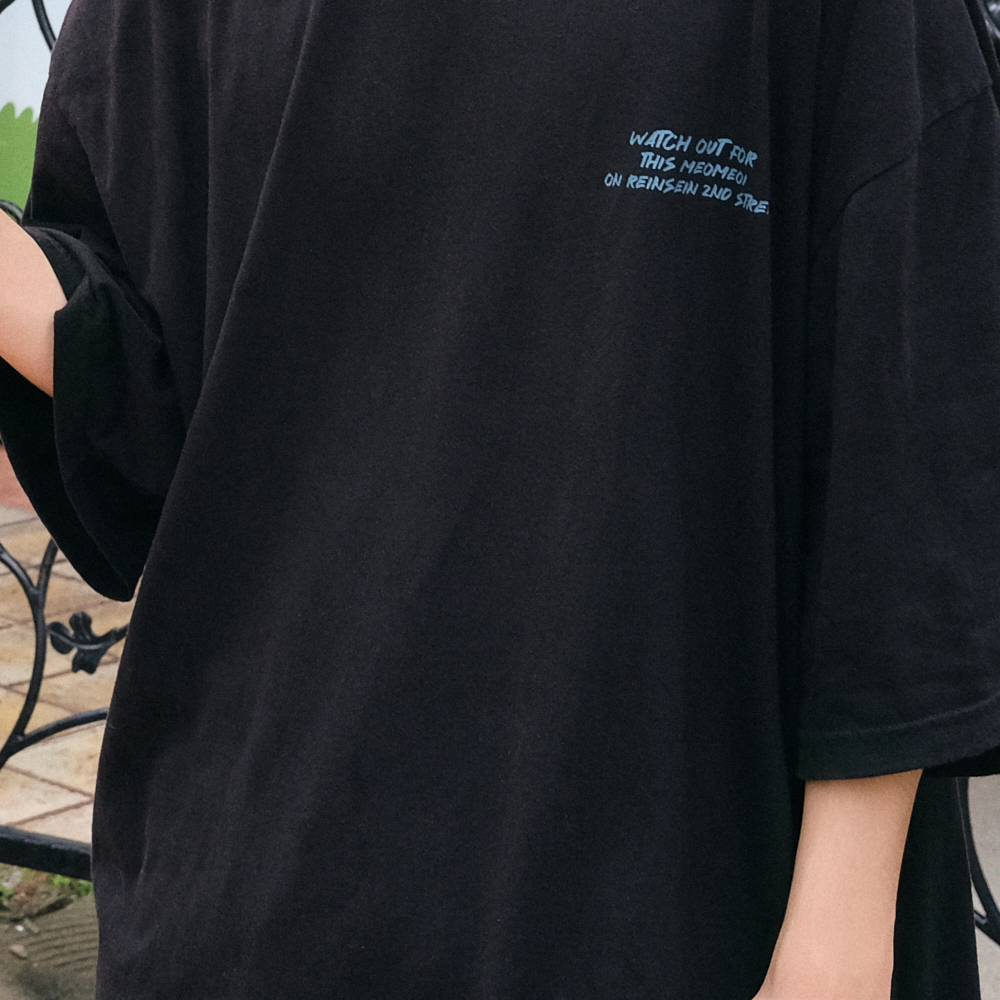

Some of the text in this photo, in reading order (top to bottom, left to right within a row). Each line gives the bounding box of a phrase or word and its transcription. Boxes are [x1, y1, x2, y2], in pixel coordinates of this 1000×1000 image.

[629, 129, 758, 168] WATCH OUT FOR
[640, 151, 676, 172] THIS
[603, 172, 770, 215] ON REINSEIN 2ND STRE
